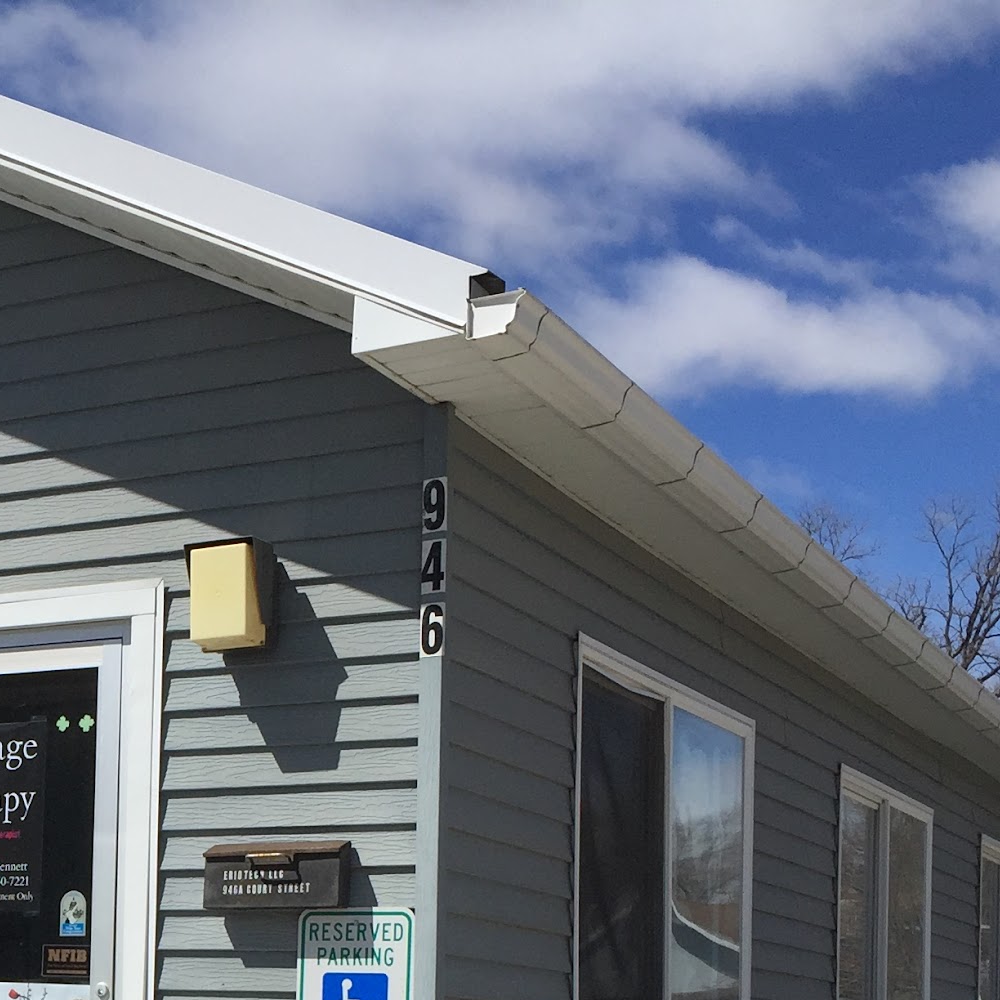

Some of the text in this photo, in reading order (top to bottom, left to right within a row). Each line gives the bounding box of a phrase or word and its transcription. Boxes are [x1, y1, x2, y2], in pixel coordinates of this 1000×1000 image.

[421, 479, 446, 655] 946
[268, 870, 284, 879] LLC
[246, 884, 272, 894] COURT
[277, 882, 310, 894] STREET
[16, 891, 33, 902] Only
[309, 923, 404, 941] RESERVED
[48, 949, 87, 962] NFIB
[317, 947, 394, 967] PARKING
